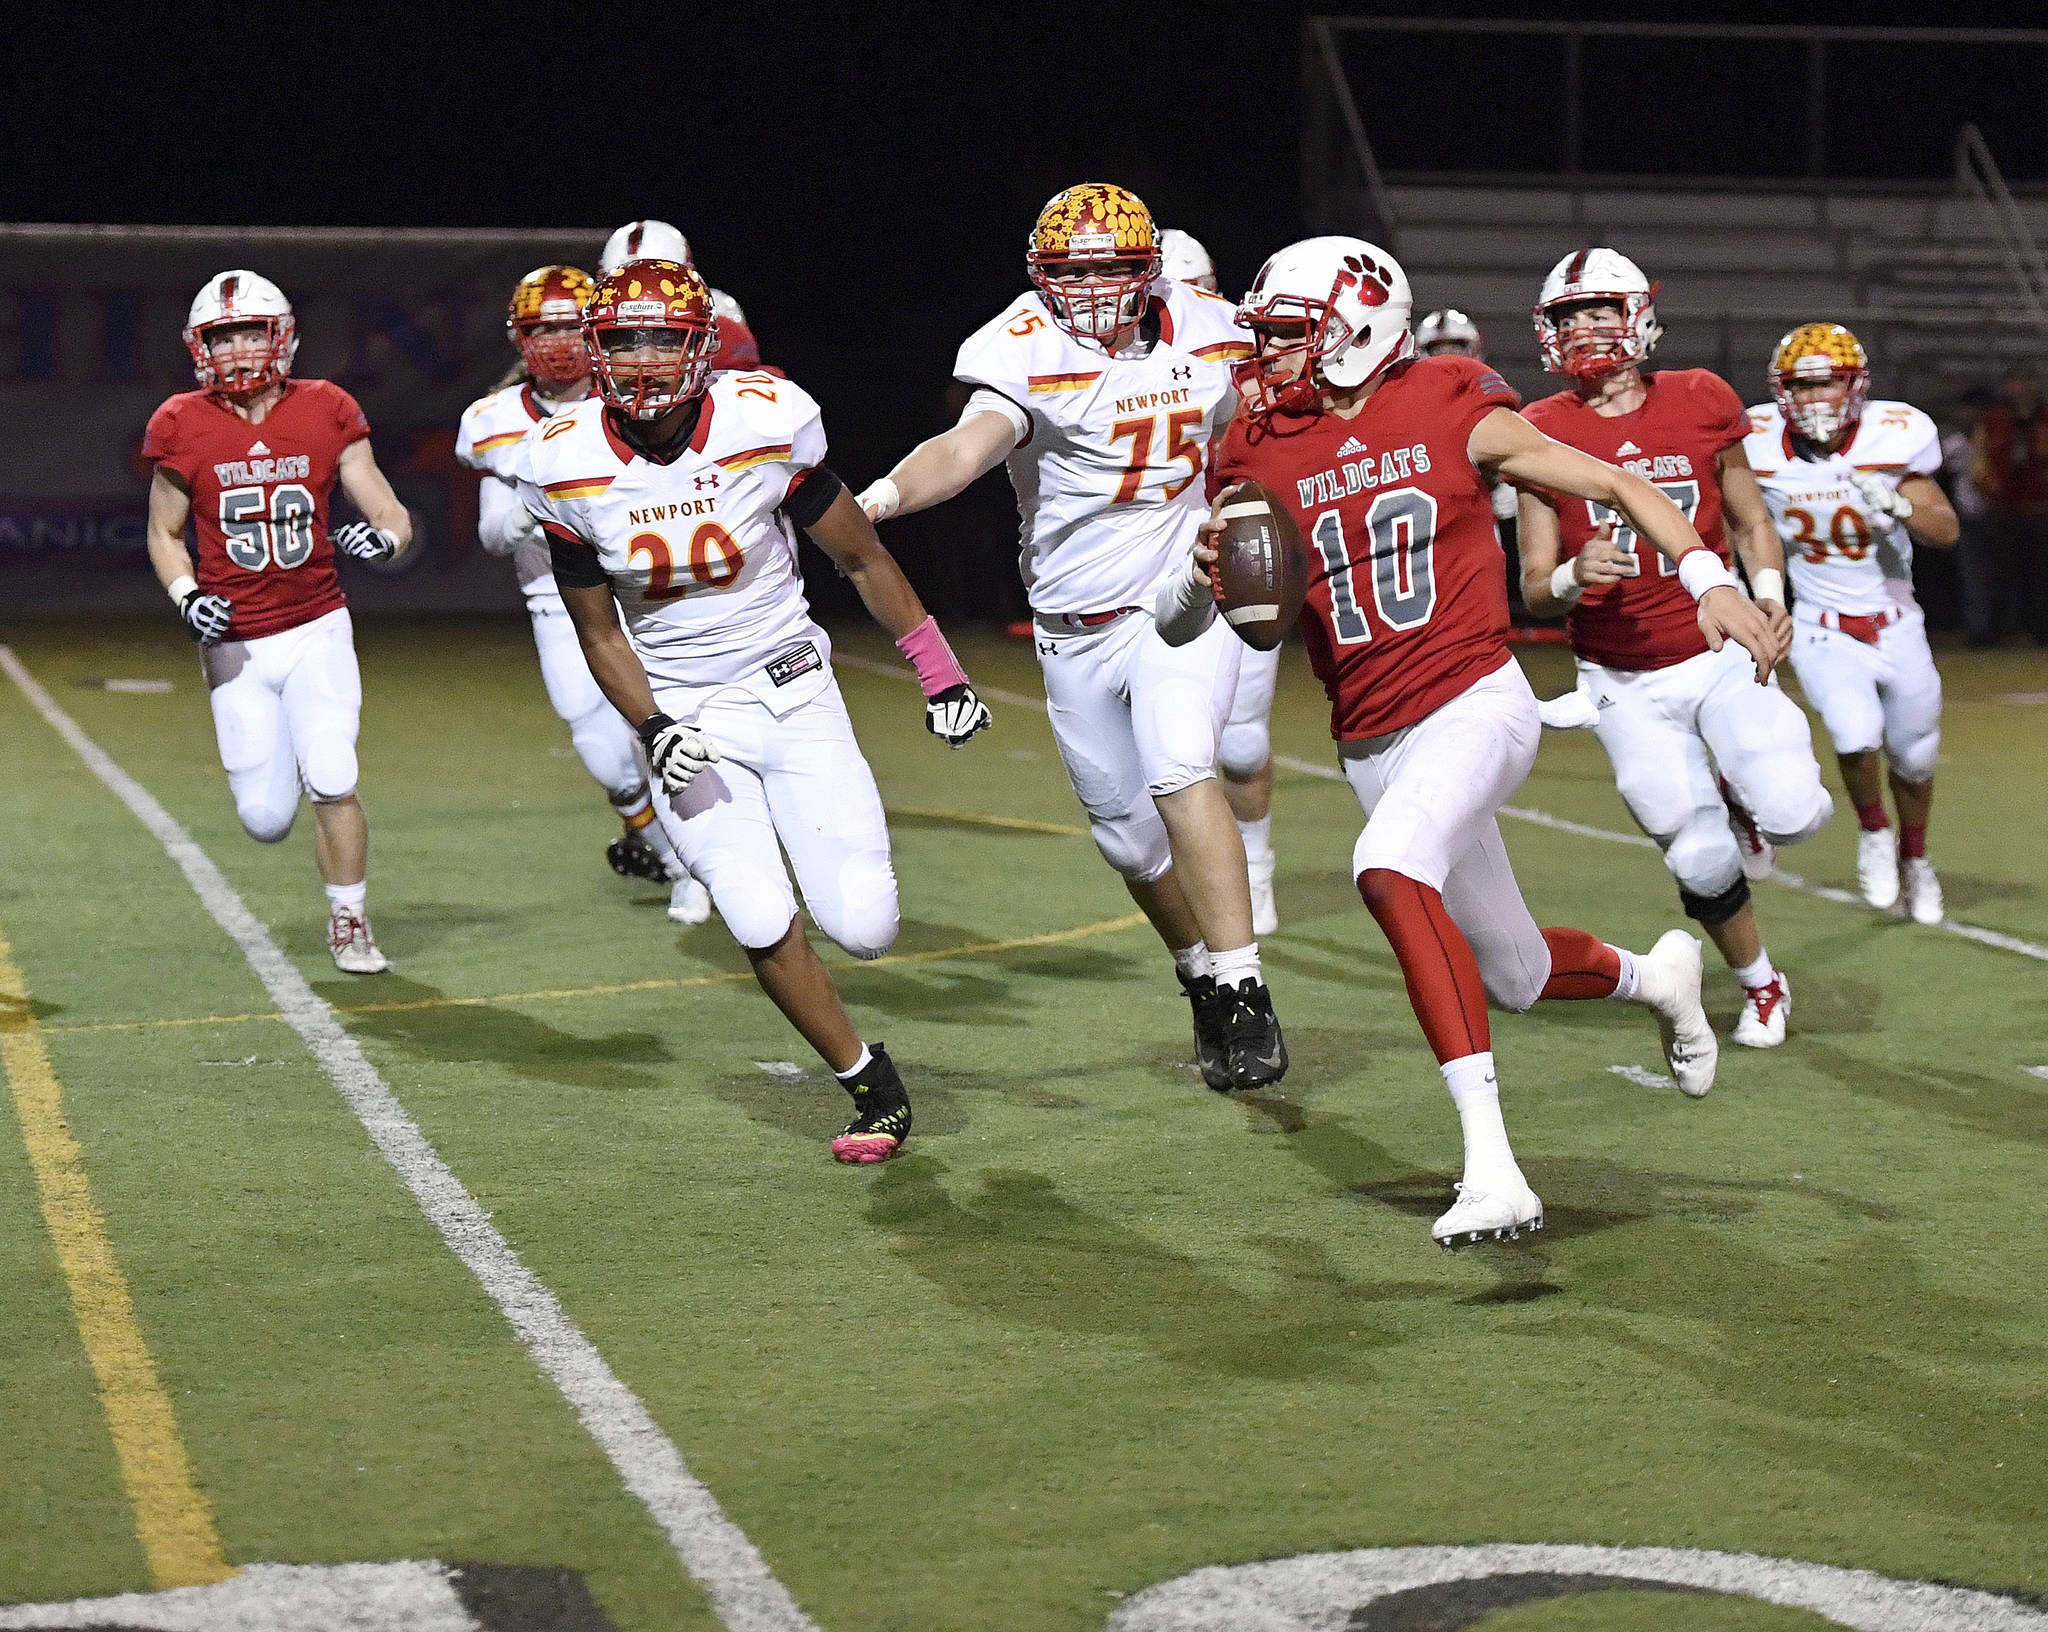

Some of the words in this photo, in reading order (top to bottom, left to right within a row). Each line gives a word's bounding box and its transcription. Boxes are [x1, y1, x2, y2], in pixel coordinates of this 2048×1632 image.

[734, 374, 778, 405] 20
[1115, 387, 1190, 414] NEWPORT
[213, 454, 311, 487] WILDCATS
[1108, 405, 1204, 505] 75
[1336, 443, 1368, 458] adidas
[1296, 443, 1432, 509] WILDCATS
[1788, 489, 1851, 504] NEWPORT
[219, 484, 316, 573] 50
[628, 497, 715, 526] NEWPORT
[1784, 505, 1871, 564] 30
[627, 520, 746, 602] 20
[1311, 486, 1438, 645] 10
